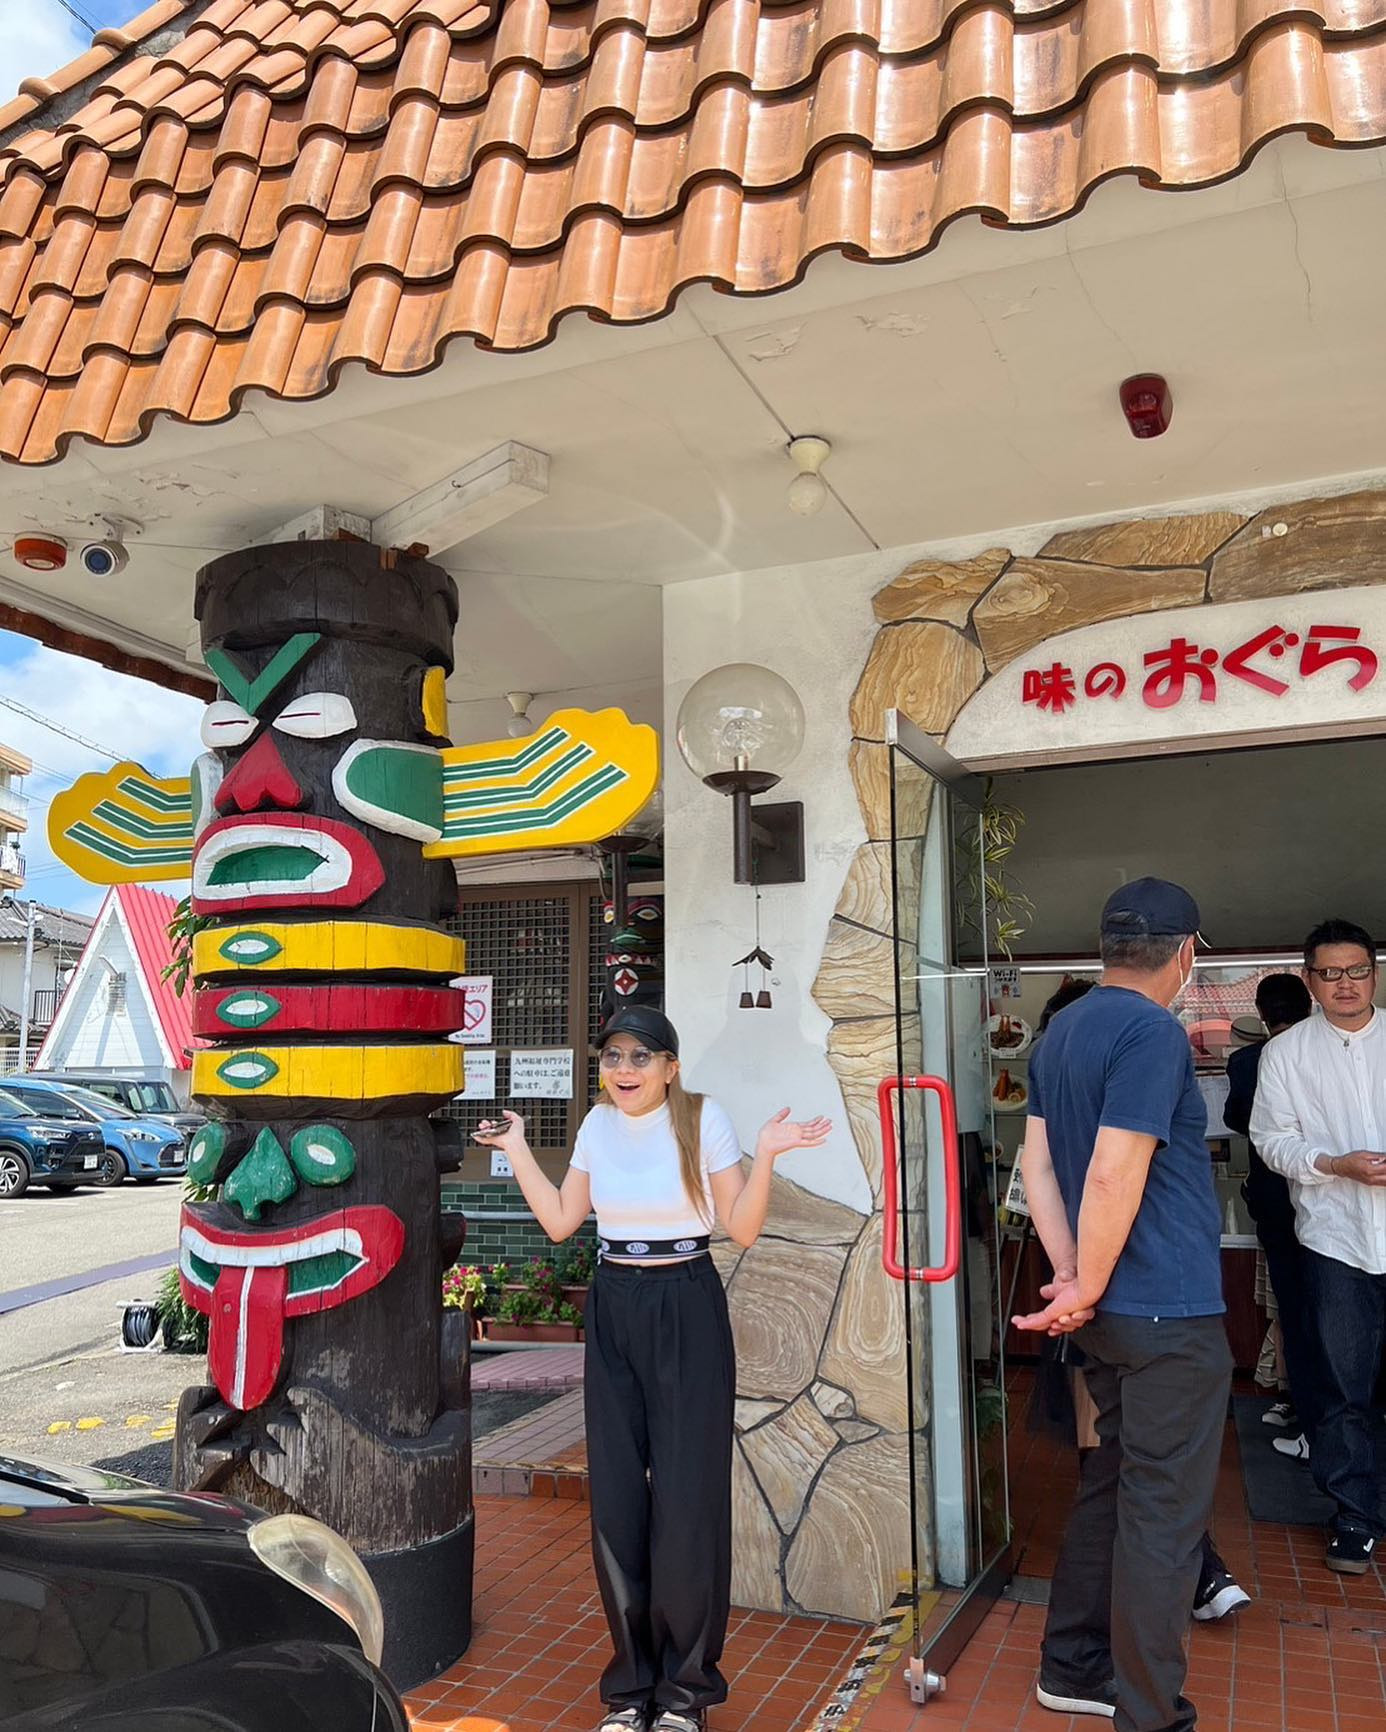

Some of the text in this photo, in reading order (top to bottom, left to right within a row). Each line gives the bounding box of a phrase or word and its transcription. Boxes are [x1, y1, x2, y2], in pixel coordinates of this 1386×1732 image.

[1022, 624, 1379, 714] 味のおぐら
[993, 969, 1017, 977] Wi-Fi
